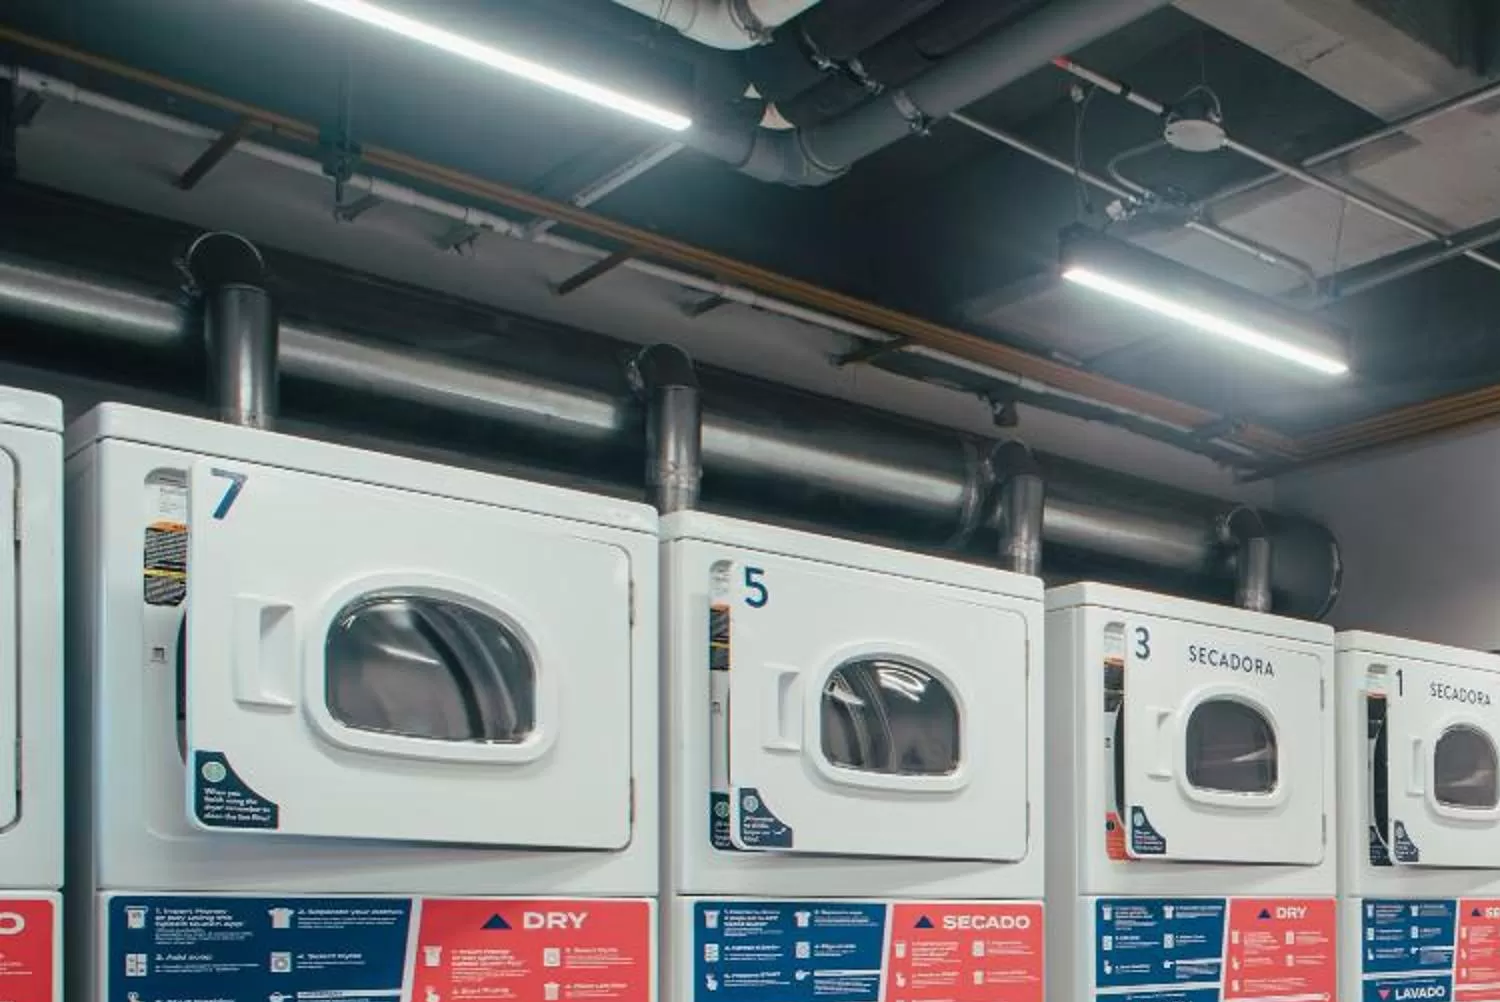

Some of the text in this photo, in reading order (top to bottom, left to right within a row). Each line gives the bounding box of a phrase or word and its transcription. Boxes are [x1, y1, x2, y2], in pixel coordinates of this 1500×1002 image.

[210, 468, 249, 519] 7
[743, 566, 769, 608] 5
[1134, 627, 1151, 659] 3
[1189, 644, 1275, 677] SECADORA
[1395, 669, 1403, 697] 1
[1430, 682, 1492, 706] SECADORA
[522, 911, 589, 929] DRY
[943, 915, 1031, 929] SECADO
[1275, 906, 1308, 919] DRY
[1395, 985, 1446, 1000] LAVADO
